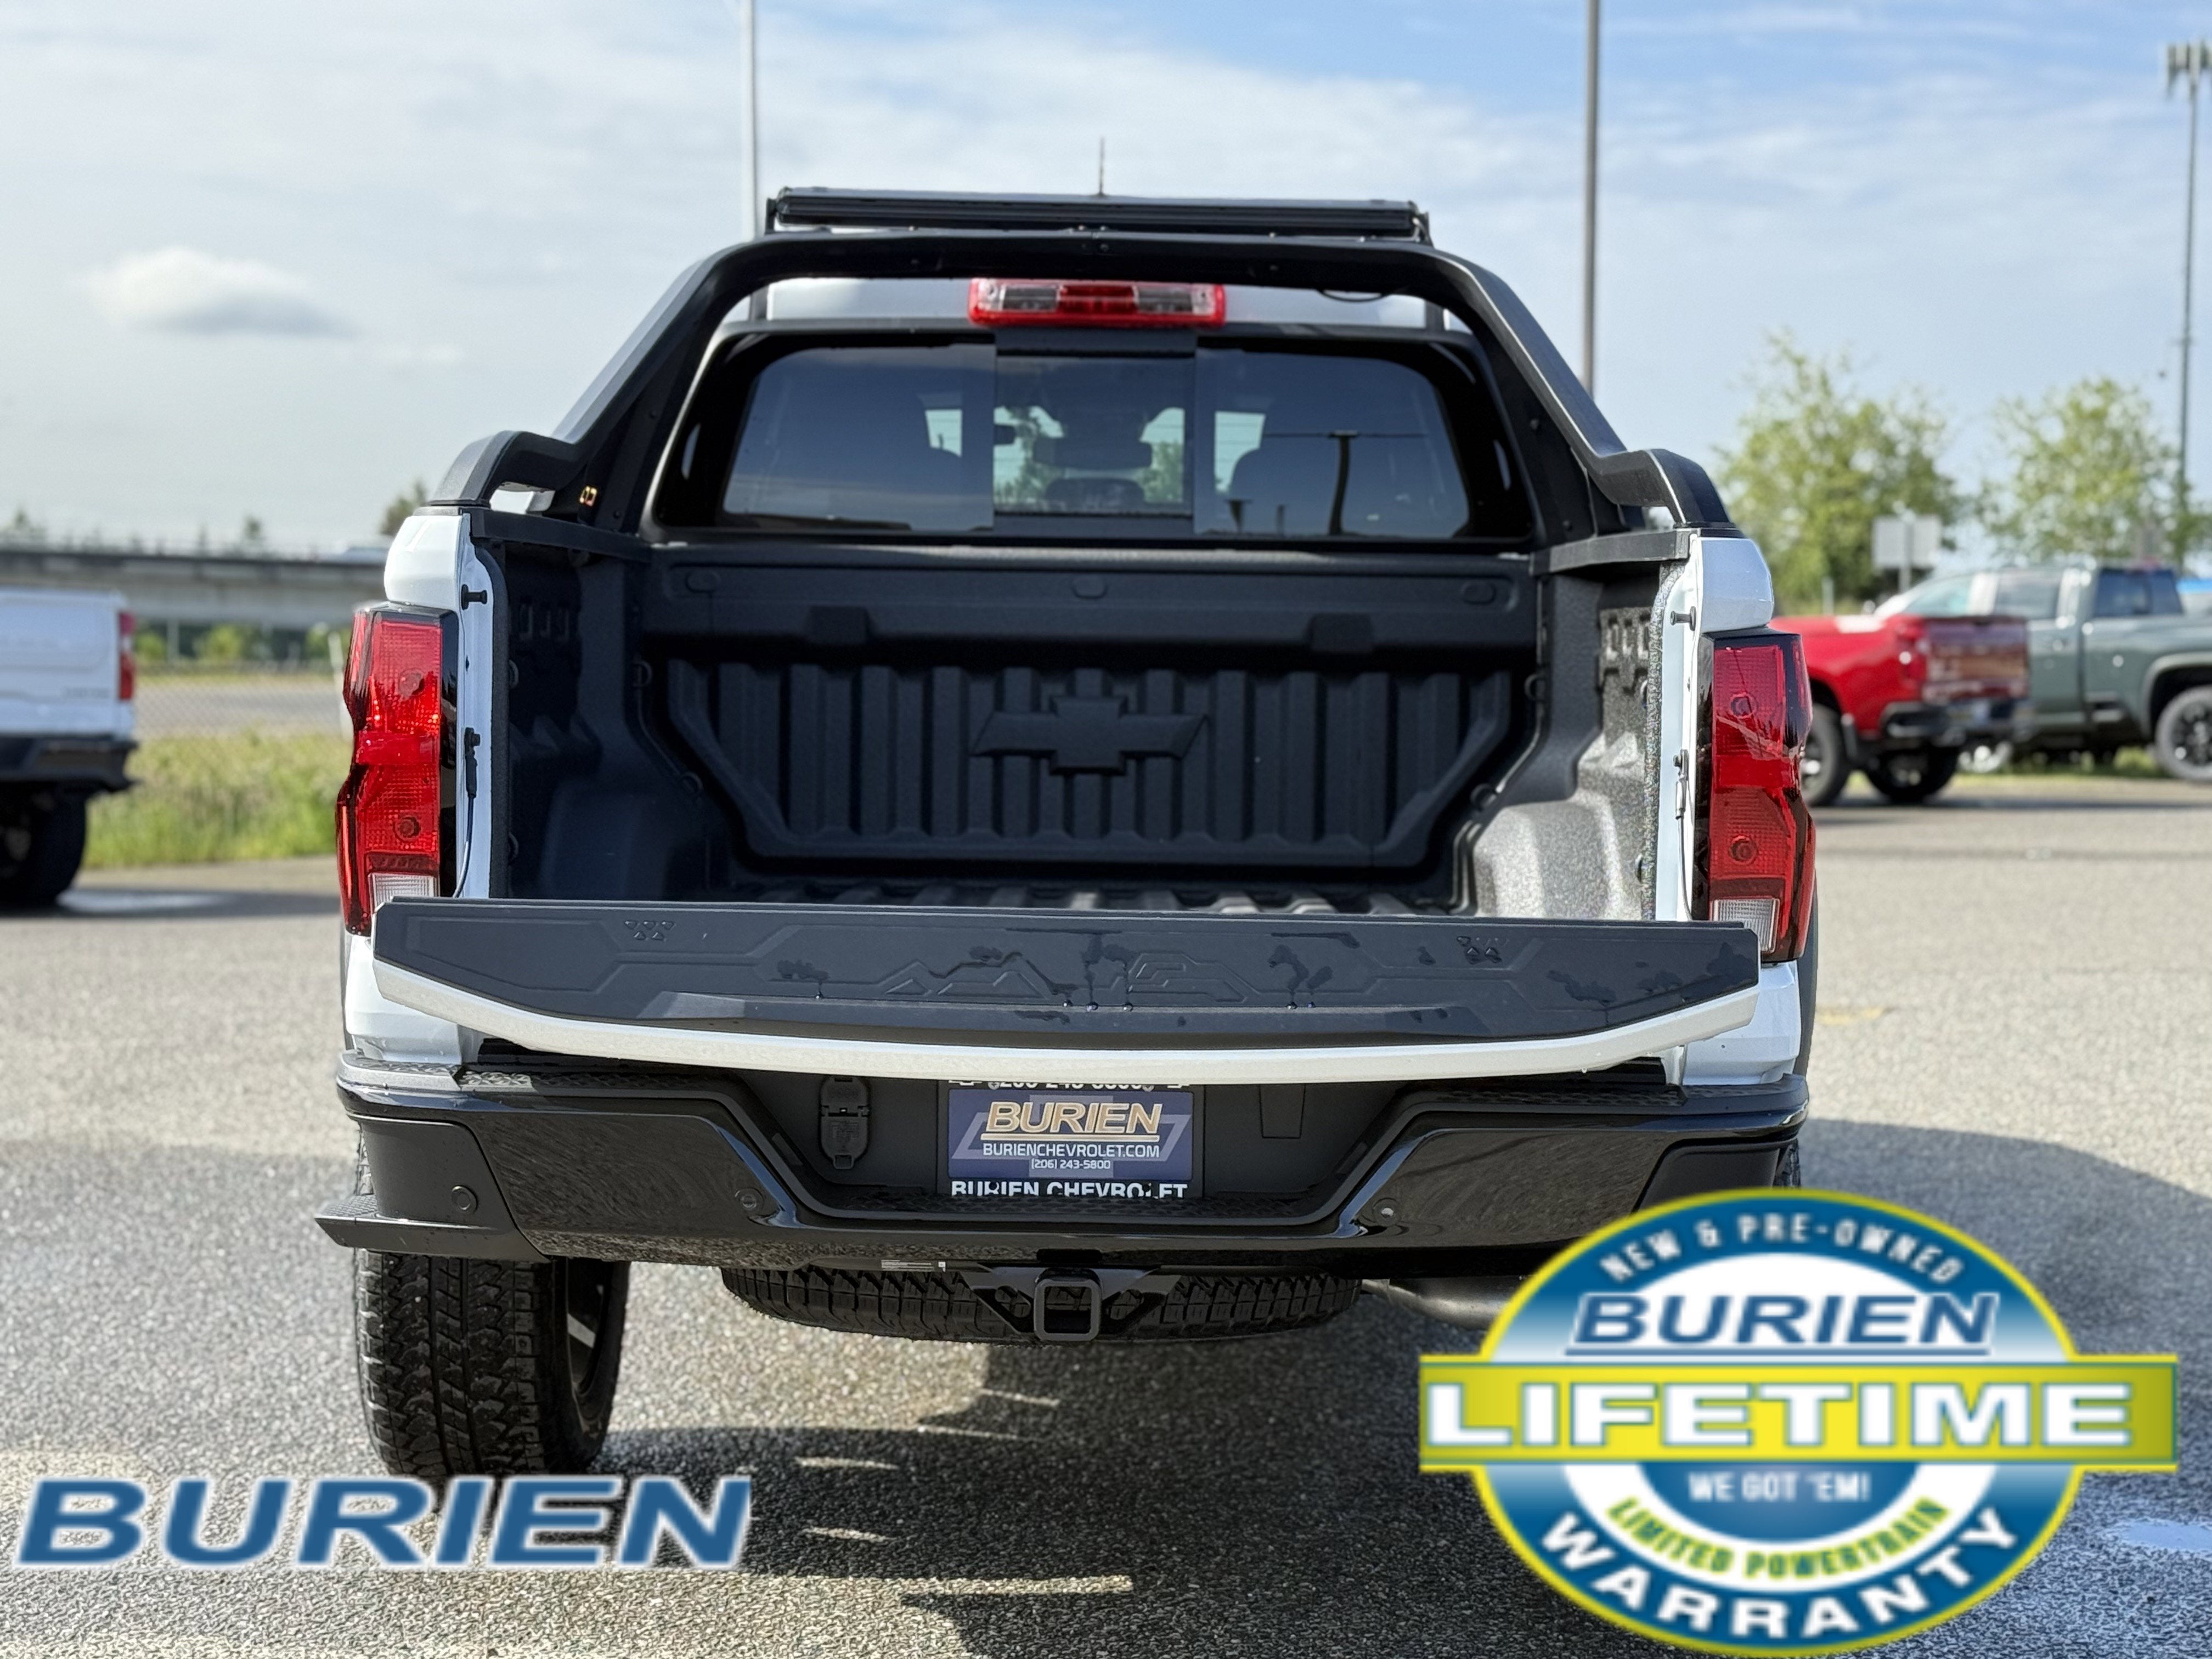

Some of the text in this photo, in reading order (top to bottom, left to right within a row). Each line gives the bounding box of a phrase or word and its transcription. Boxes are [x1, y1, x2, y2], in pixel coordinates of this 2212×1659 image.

[985, 1101, 1164, 1134] BURIEN
[983, 1143, 1160, 1158] BURIENCHEVROLET.COM
[1031, 1159, 1111, 1170] (206) 243-5800
